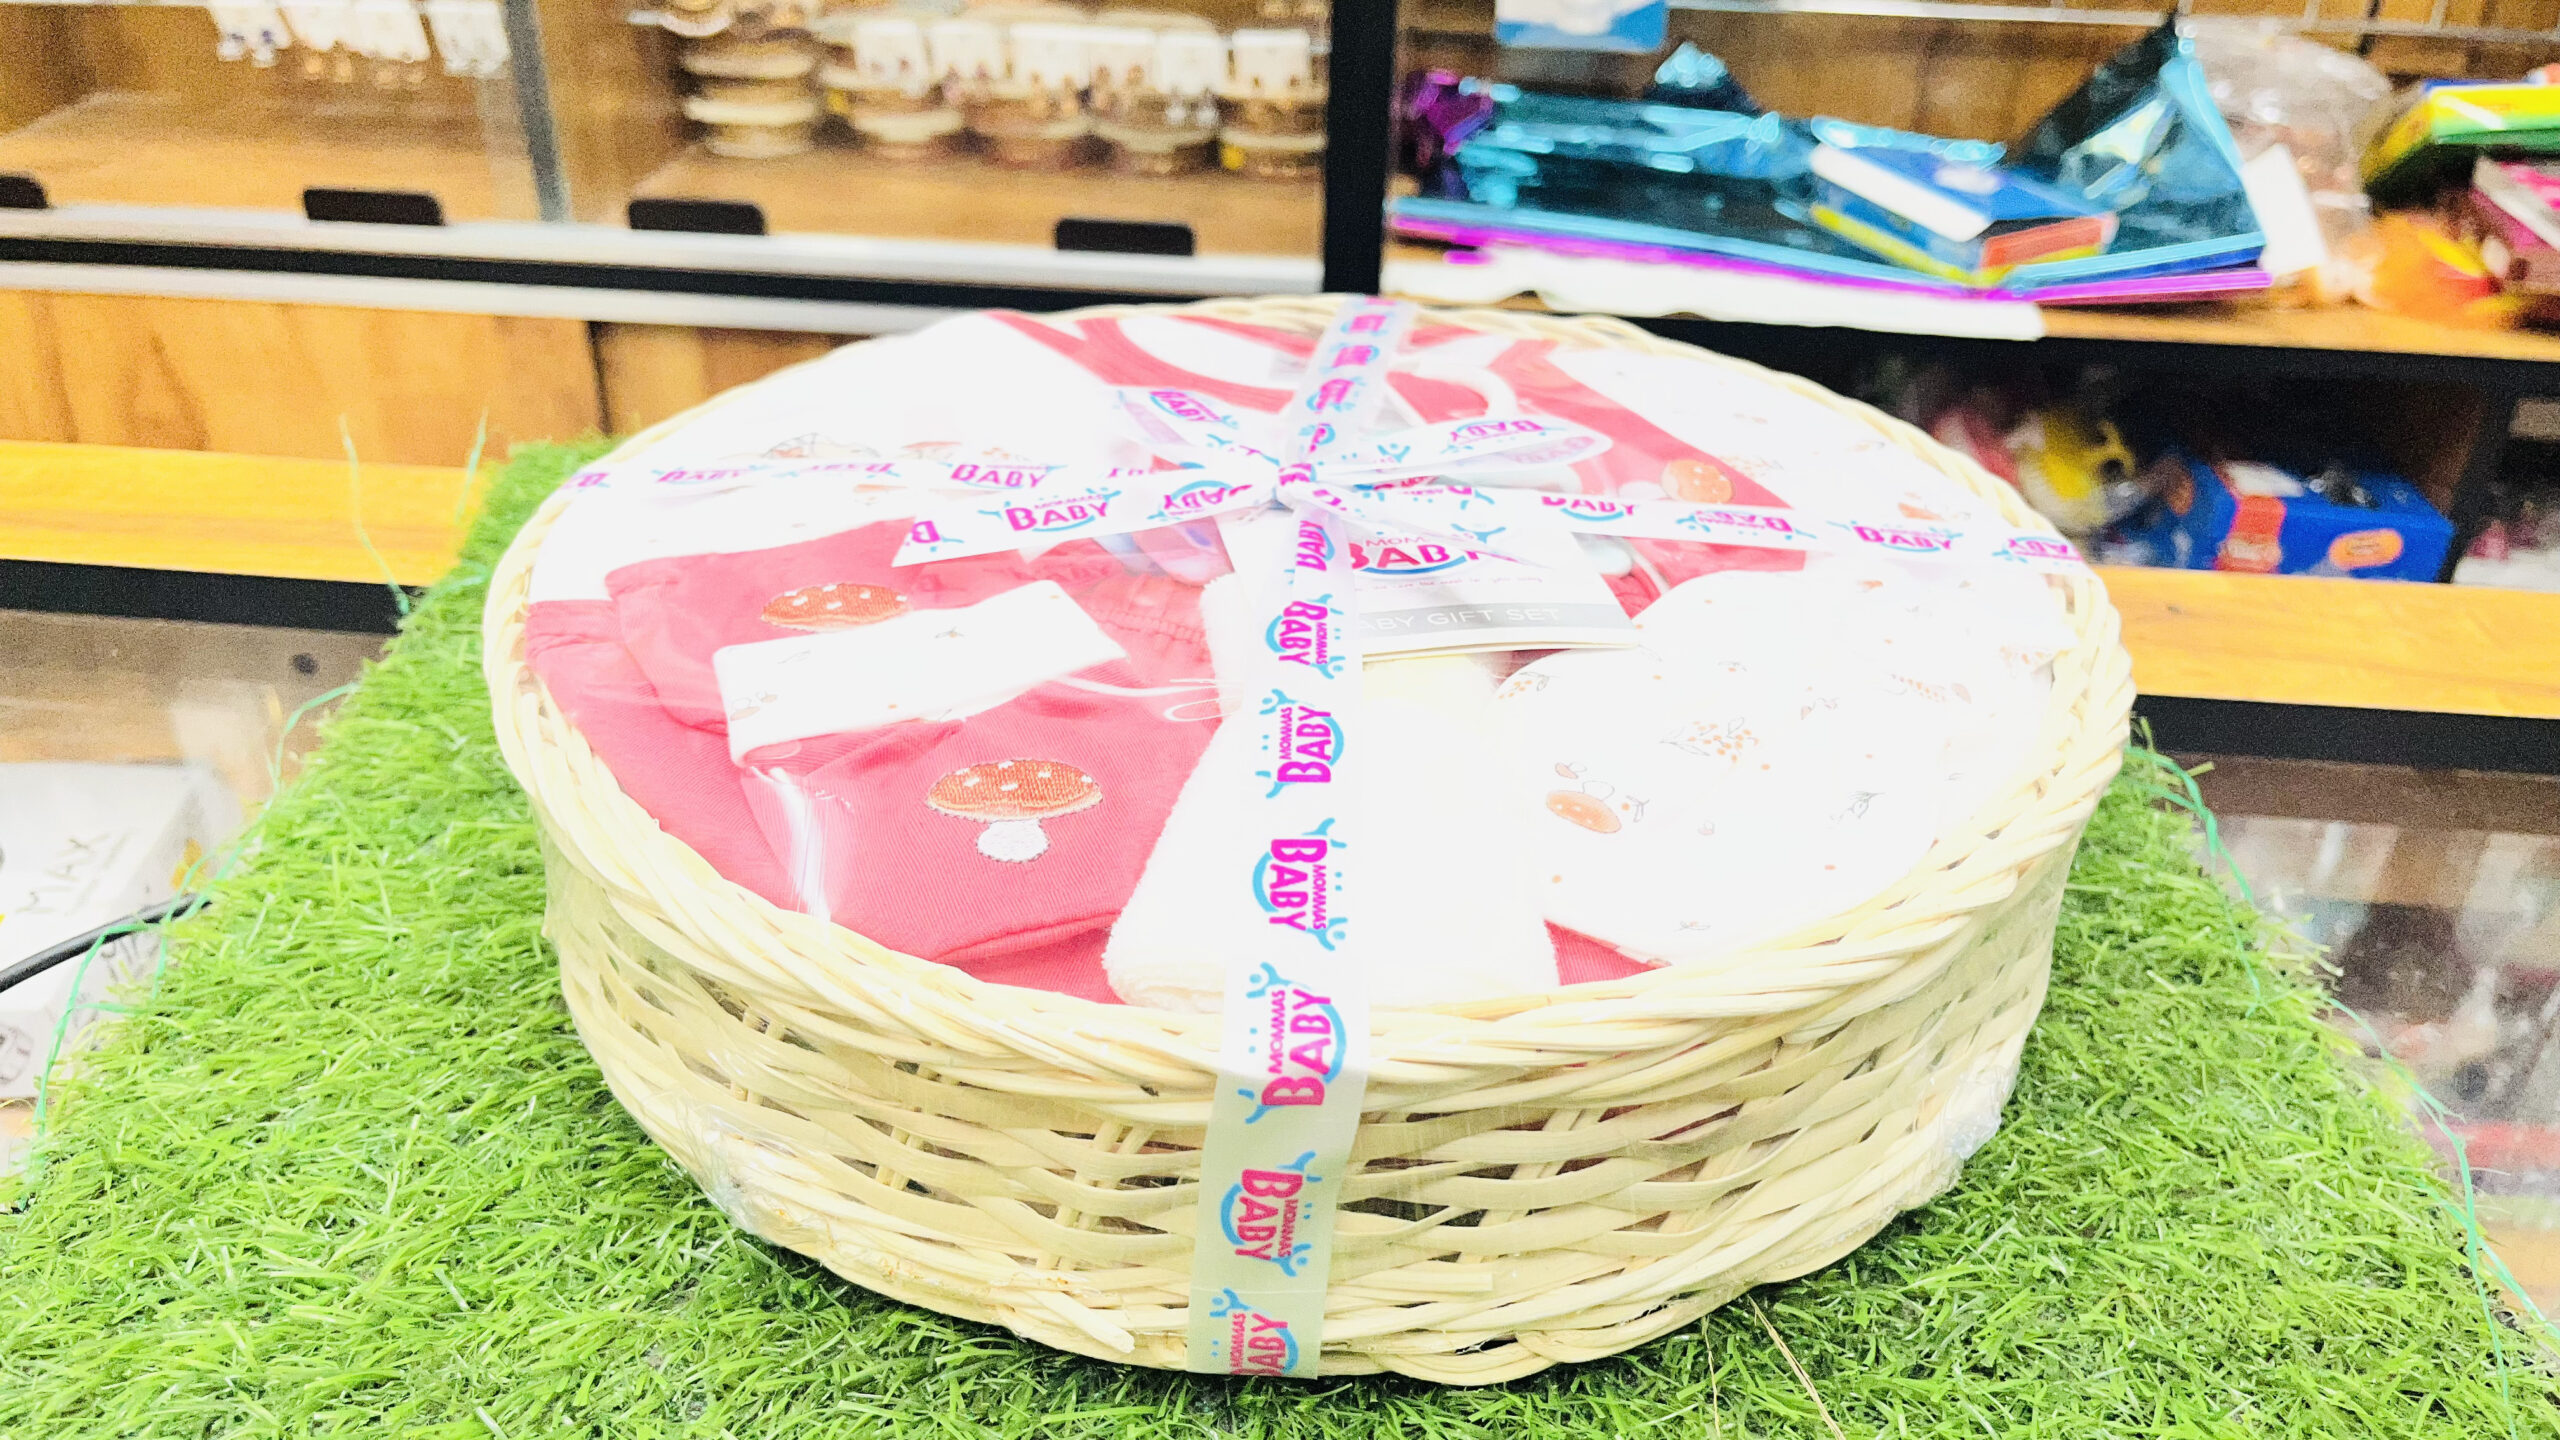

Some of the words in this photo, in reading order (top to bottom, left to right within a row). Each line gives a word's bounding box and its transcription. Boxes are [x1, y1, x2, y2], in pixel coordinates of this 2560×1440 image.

[1450, 419, 1544, 442] BABY
[950, 463, 1047, 489] BABY
[1163, 483, 1253, 510] ABY
[1005, 501, 1108, 532] BABY
[1852, 525, 1952, 551] BABY
[1278, 600, 1329, 666] BABY
[1427, 609, 1493, 625] GIFT
[1505, 608, 1560, 622] SET
[1276, 705, 1333, 784] BABY
[1279, 706, 1293, 761] MOMMAS
[1268, 838, 1329, 931] BABY
[1311, 863, 1327, 930] MOMMAS
[1261, 988, 1332, 1107] BABY
[1267, 989, 1287, 1076] MOMMAS
[1234, 1168, 1304, 1261] BABY
